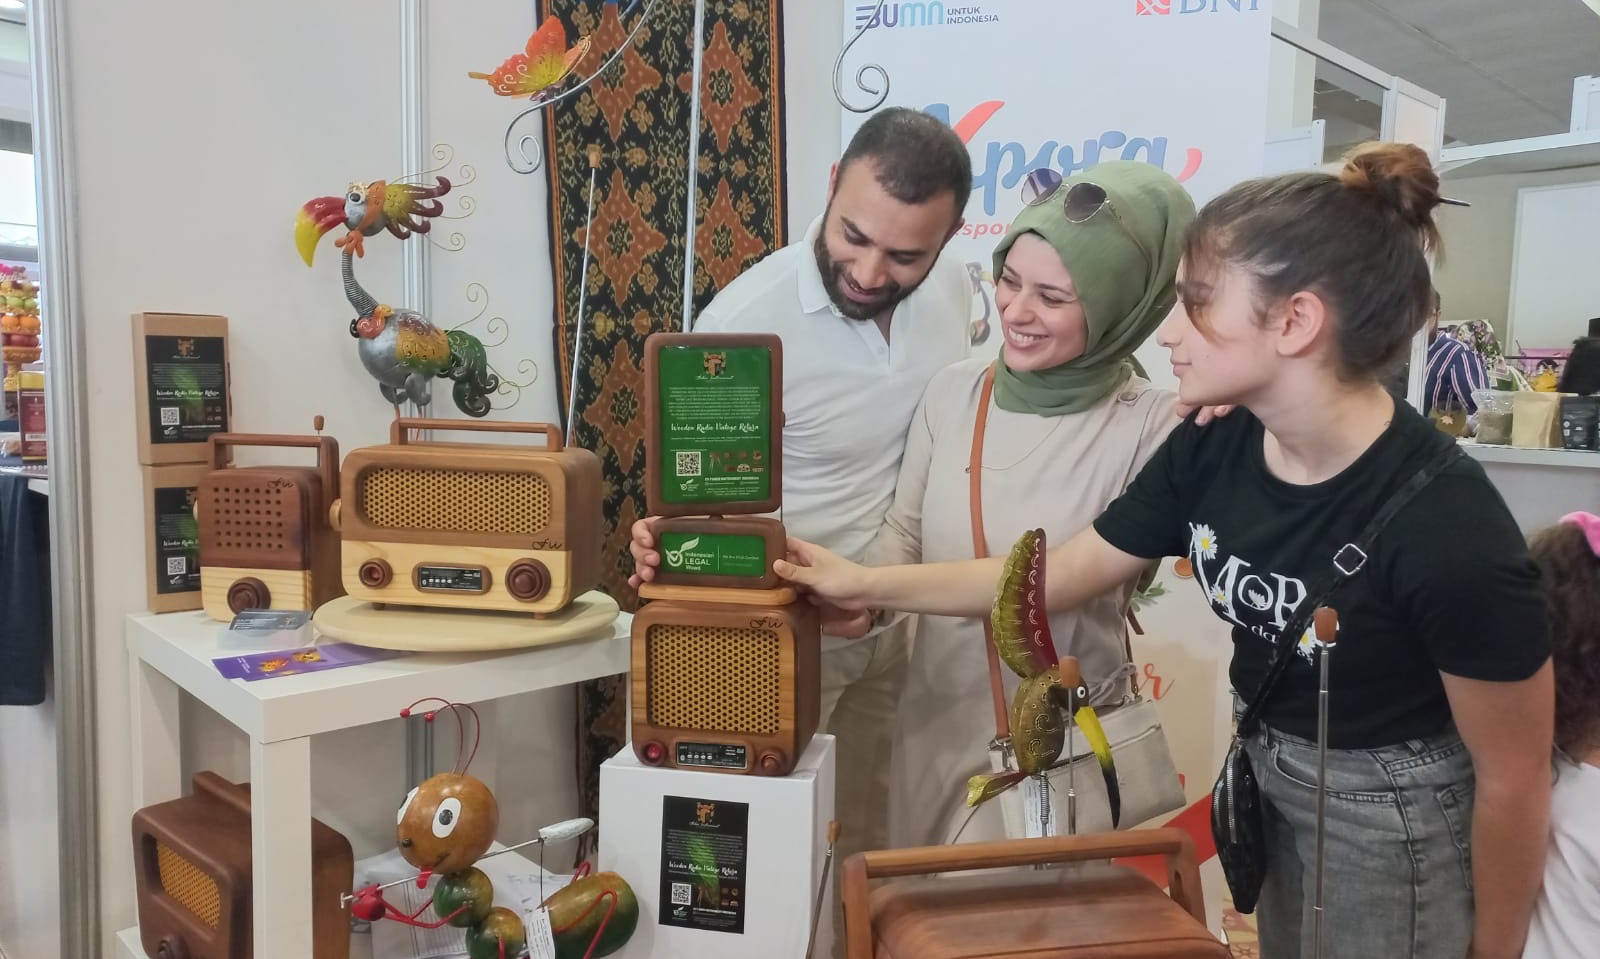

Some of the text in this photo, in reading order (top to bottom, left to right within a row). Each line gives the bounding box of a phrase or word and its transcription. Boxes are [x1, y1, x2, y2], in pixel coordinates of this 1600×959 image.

[947, 7, 981, 16] UNTUK
[947, 15, 999, 24] INDONESIA
[684, 557, 712, 566] LEGAL
